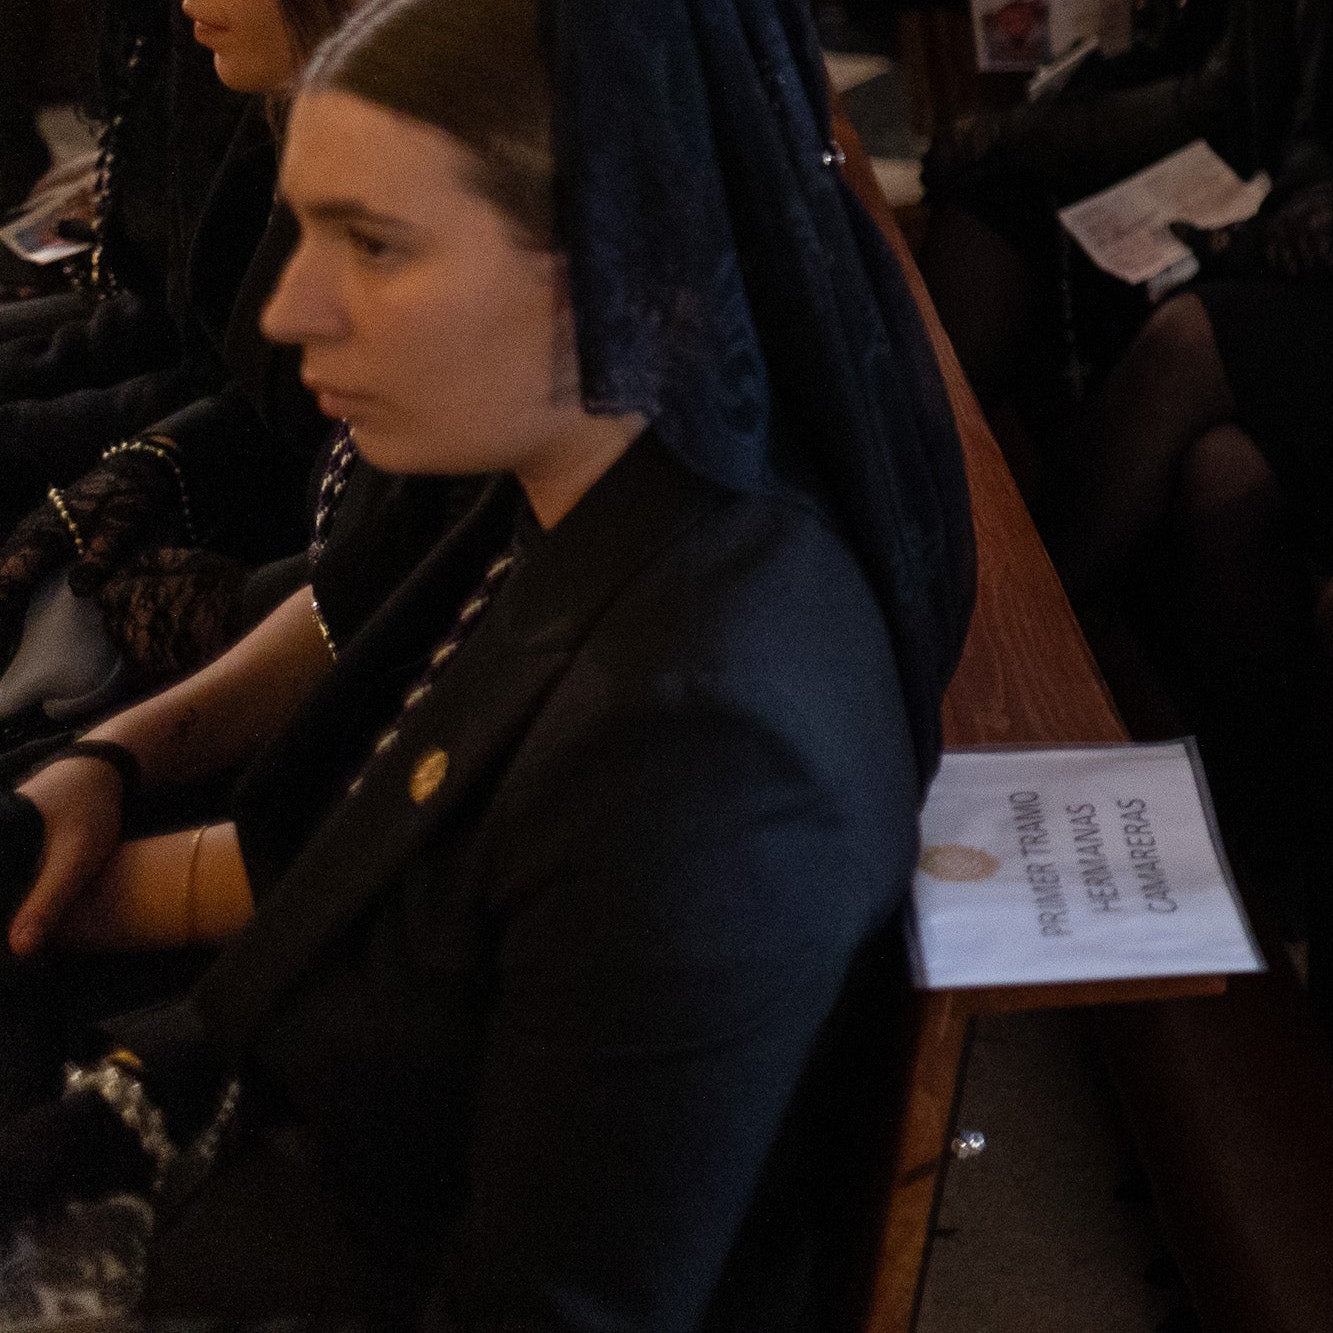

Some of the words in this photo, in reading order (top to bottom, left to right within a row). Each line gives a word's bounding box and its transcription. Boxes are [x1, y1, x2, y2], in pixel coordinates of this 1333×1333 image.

[1009, 790, 1049, 858] TRAMO
[1066, 802, 1120, 913] HERMANAS
[1117, 797, 1178, 914] CAMARERAS
[1026, 863, 1071, 937] PRIMER
